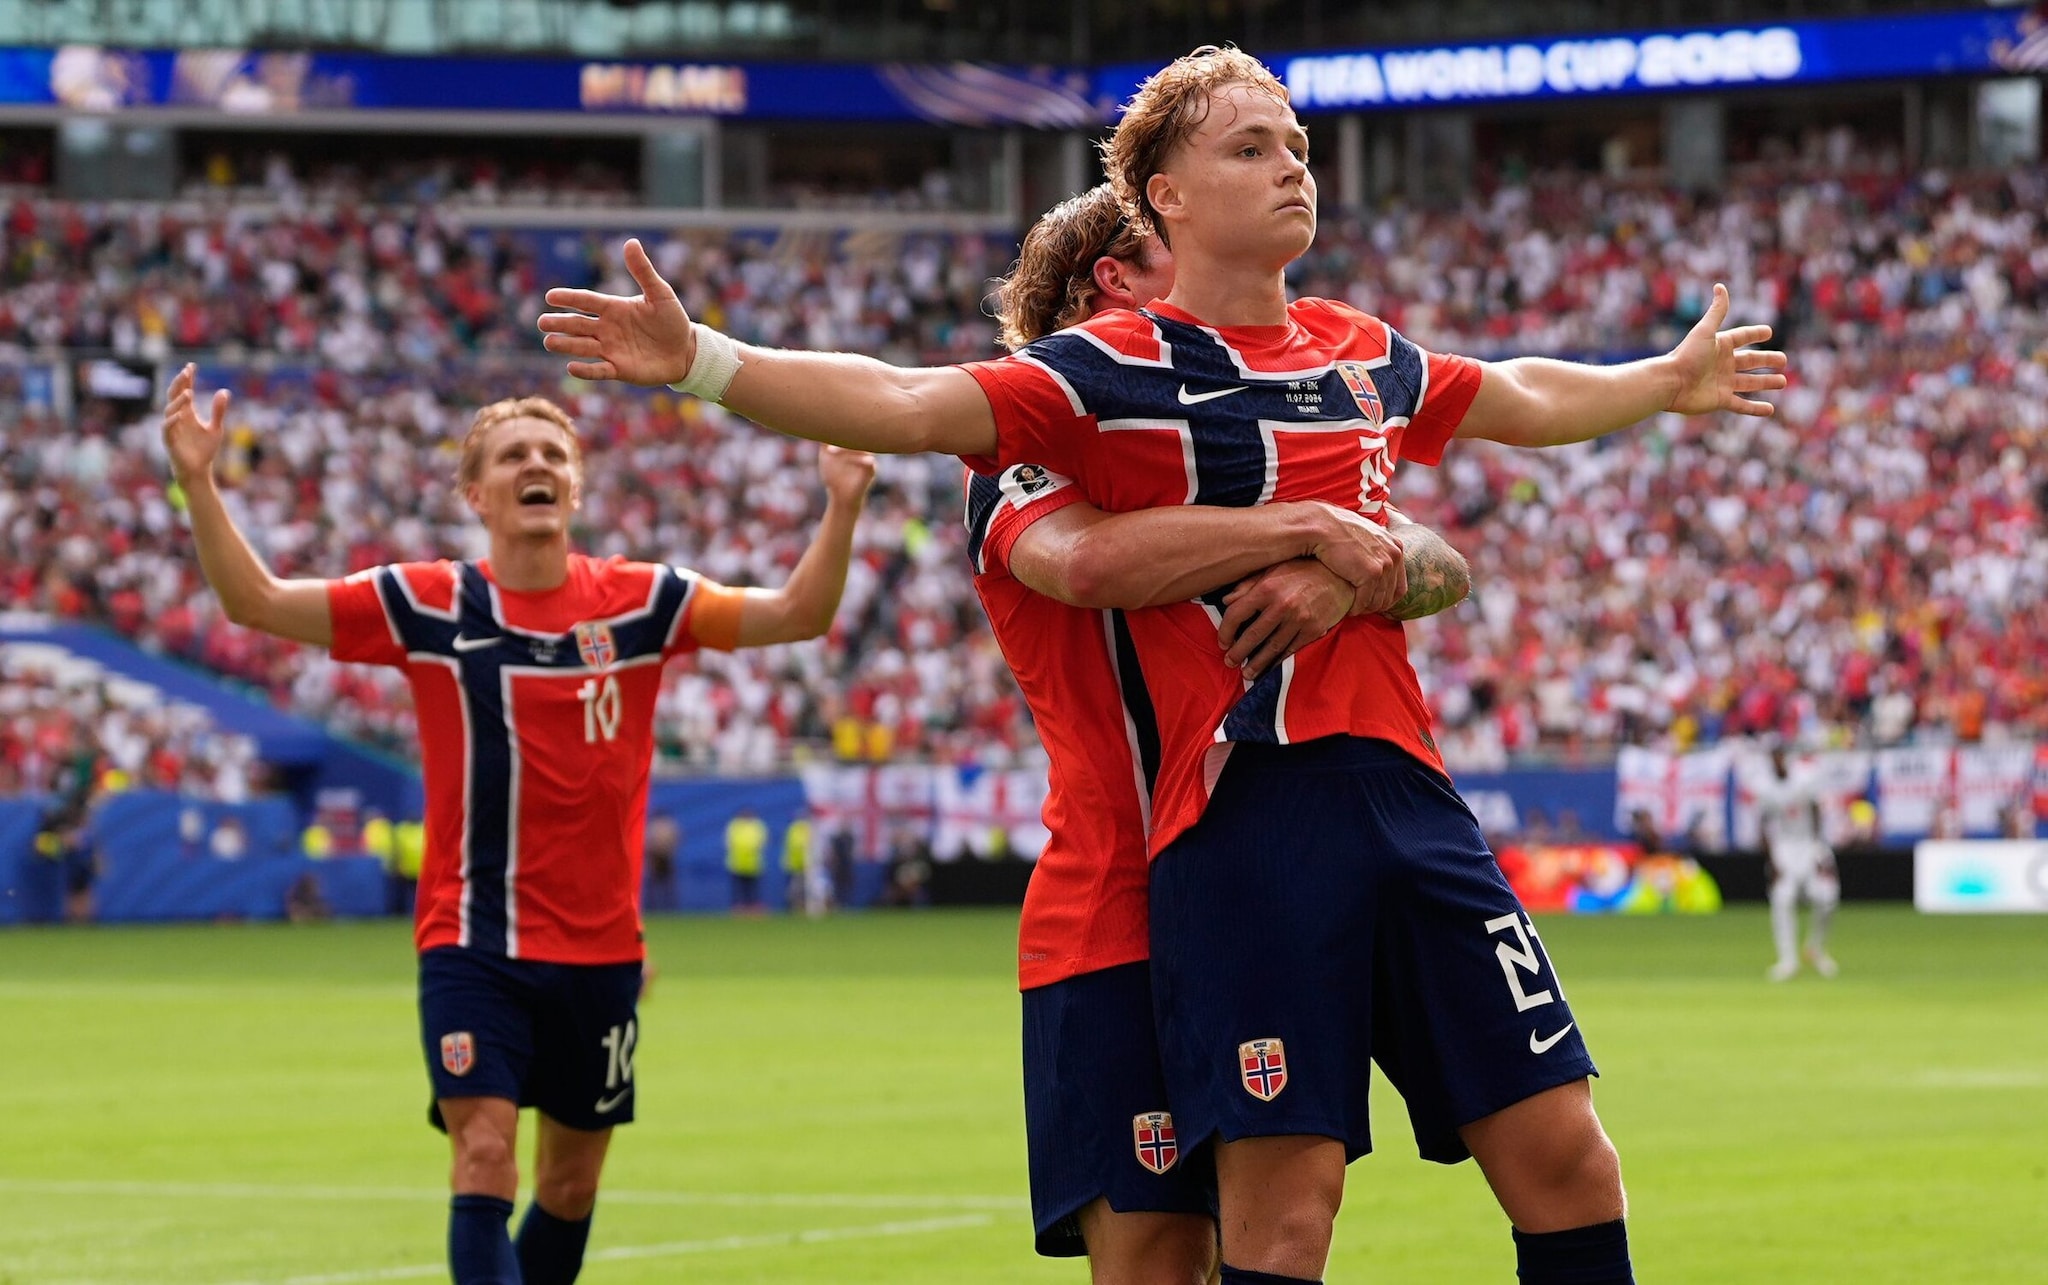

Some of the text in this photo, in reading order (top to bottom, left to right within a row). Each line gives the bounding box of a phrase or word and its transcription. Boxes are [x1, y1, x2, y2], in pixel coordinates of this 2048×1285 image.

[580, 64, 747, 113] MIAMI
[1287, 27, 1800, 108] FIFA WORLD CUP 2026
[1285, 393, 1322, 403] 11.07.2026
[577, 675, 621, 743] 10
